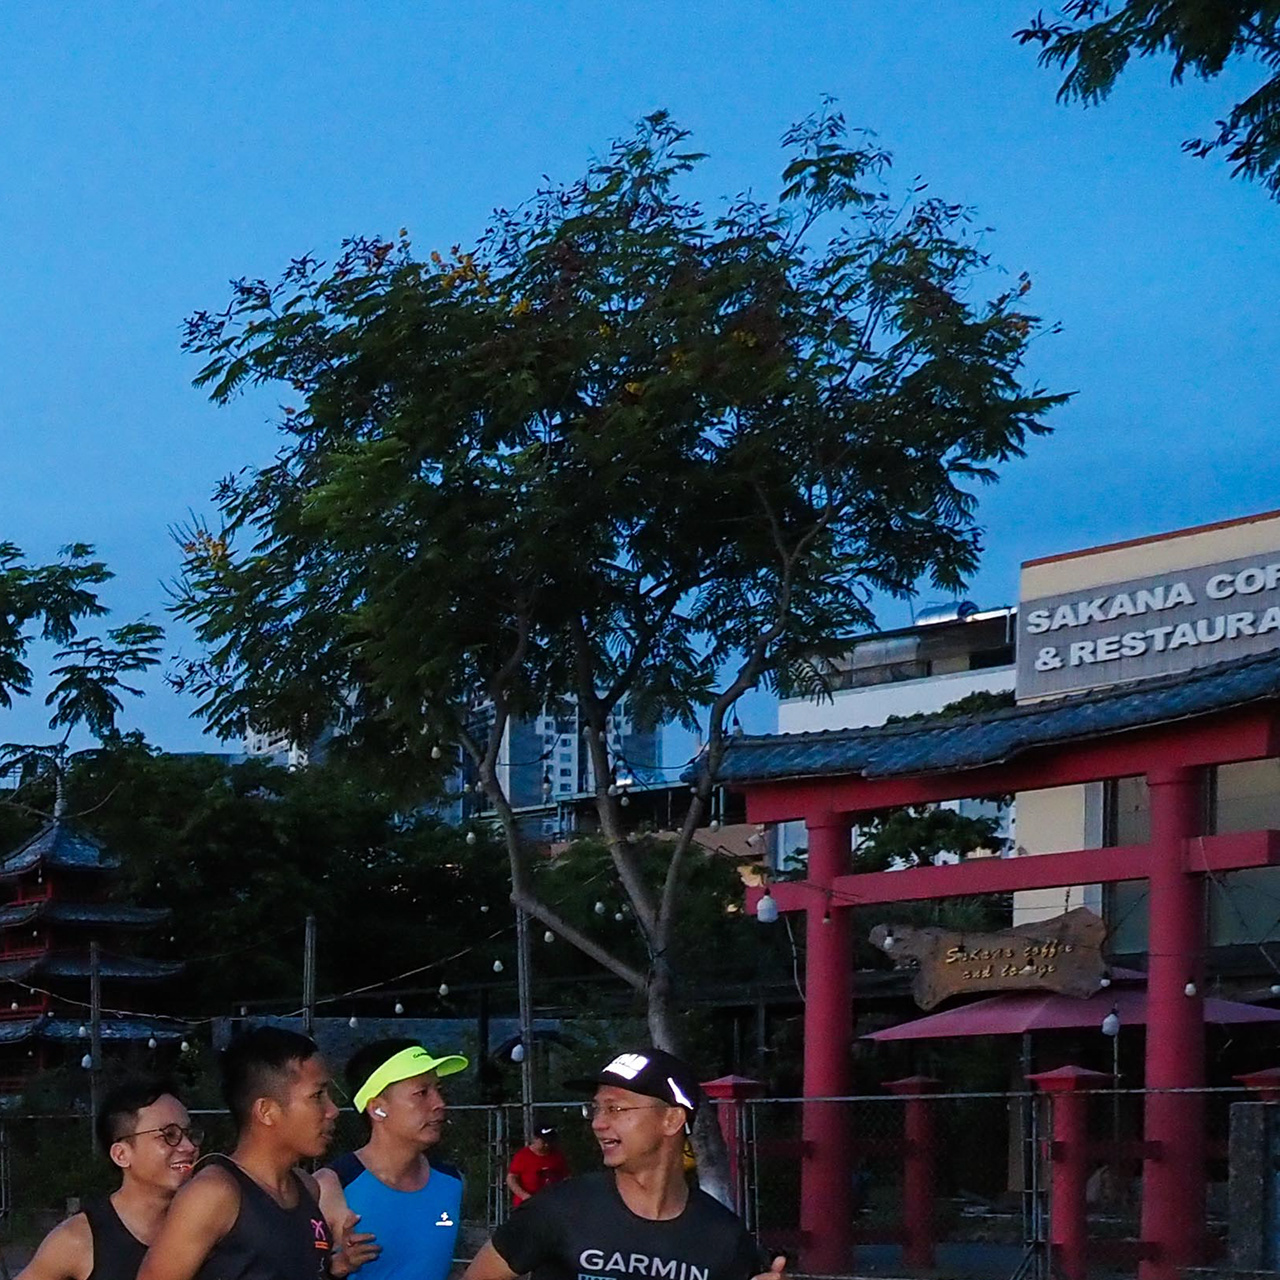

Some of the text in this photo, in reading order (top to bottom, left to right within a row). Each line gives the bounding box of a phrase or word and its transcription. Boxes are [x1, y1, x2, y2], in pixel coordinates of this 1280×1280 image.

[1026, 581, 1196, 634] SAKANA
[1035, 606, 1280, 672] & RESTAURA
